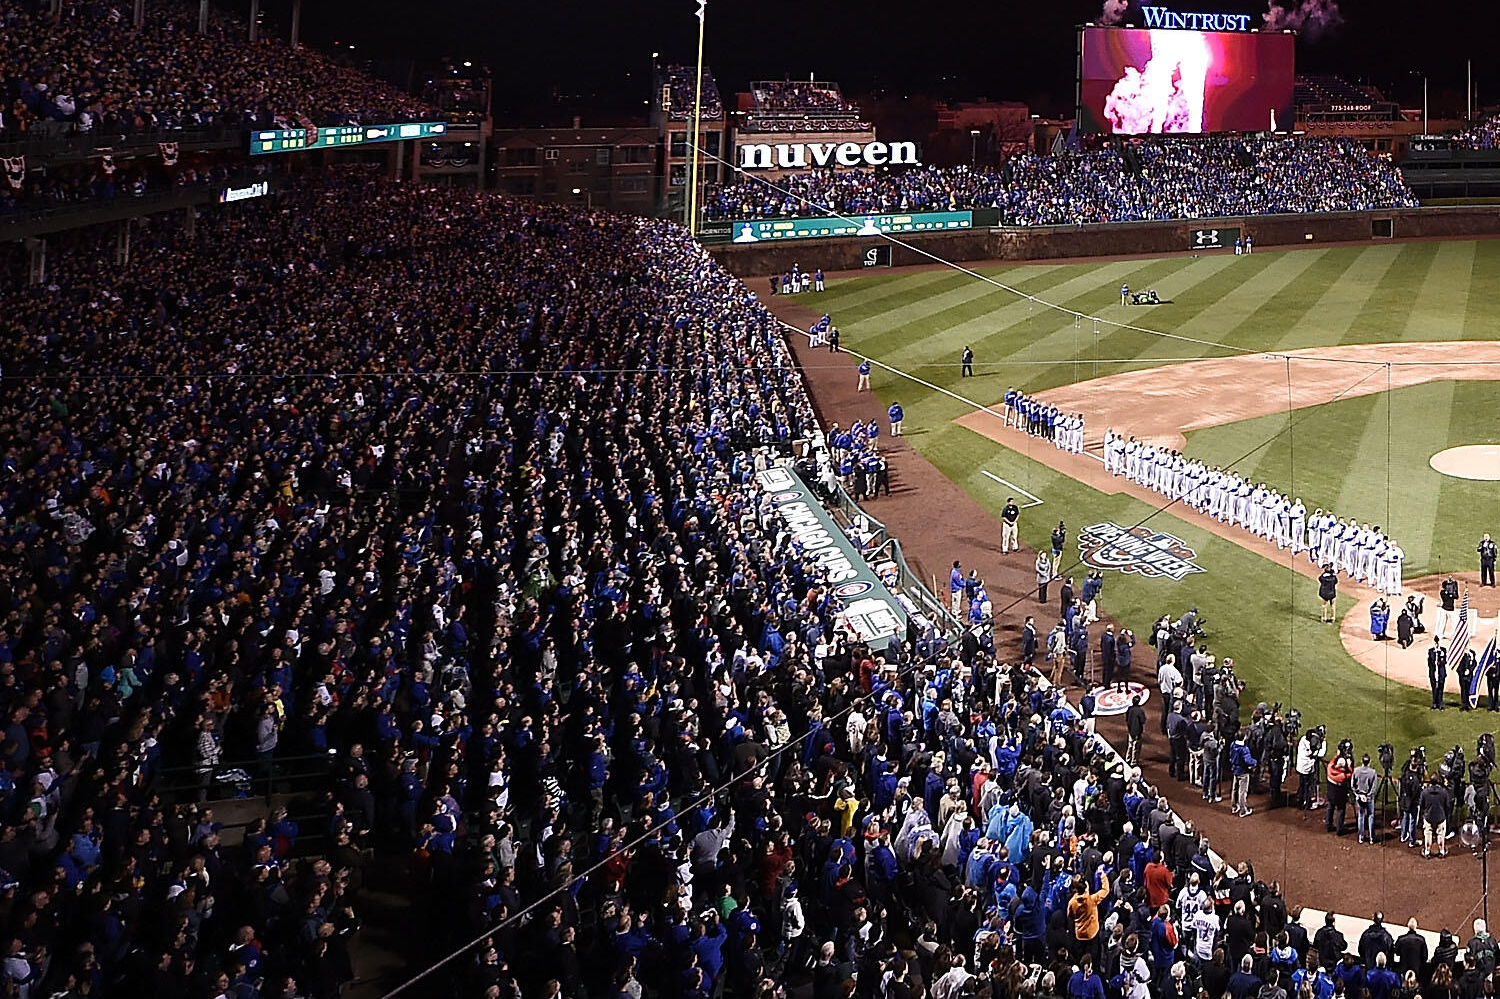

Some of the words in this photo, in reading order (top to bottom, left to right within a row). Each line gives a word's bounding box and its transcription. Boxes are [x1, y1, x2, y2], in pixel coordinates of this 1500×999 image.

[1142, 6, 1250, 31] WINTRUST
[740, 139, 918, 169] nuveen
[1082, 522, 1155, 559] OPENING
[1144, 549, 1197, 578] WEEK
